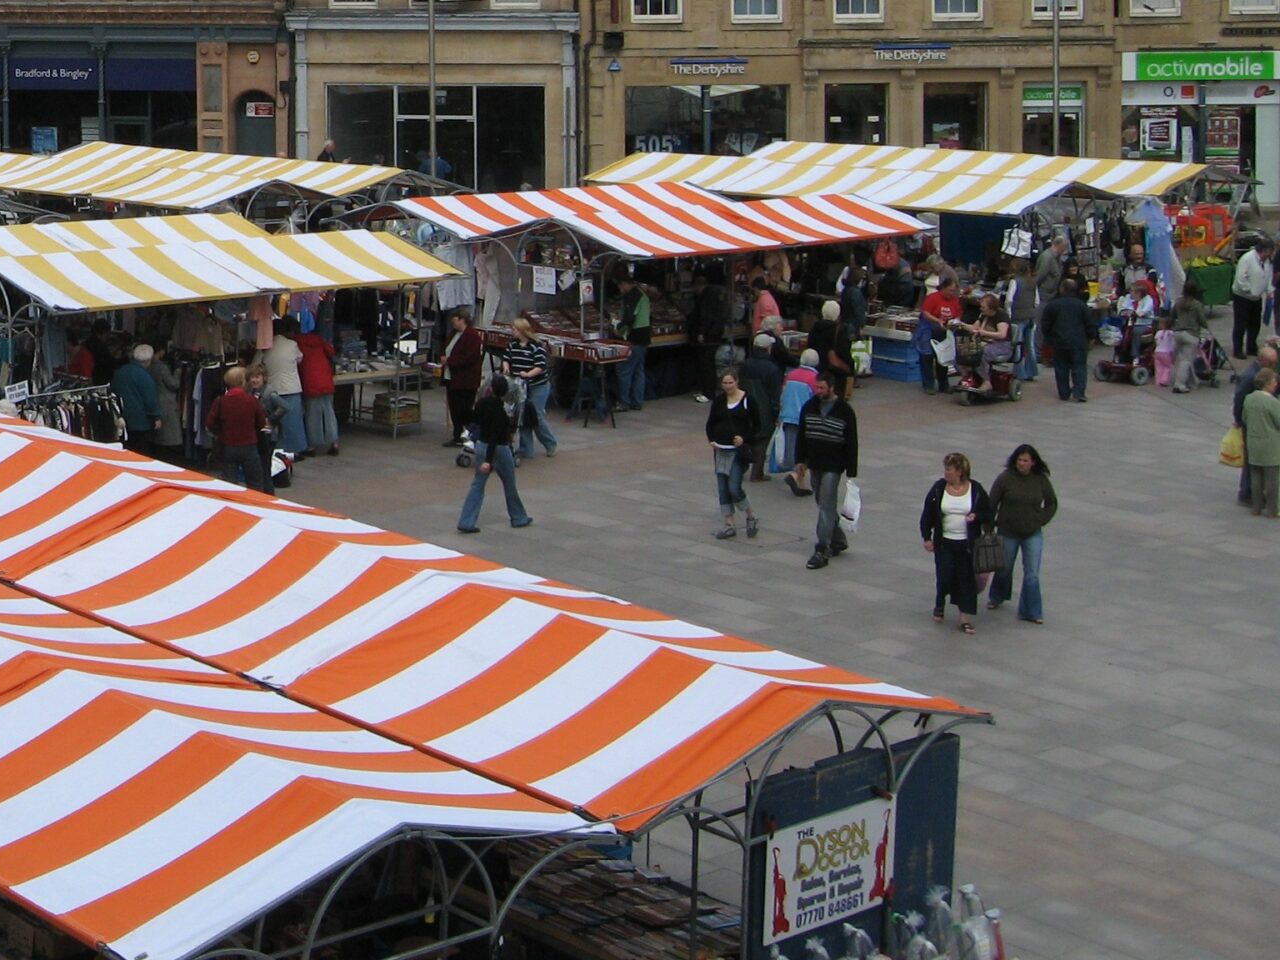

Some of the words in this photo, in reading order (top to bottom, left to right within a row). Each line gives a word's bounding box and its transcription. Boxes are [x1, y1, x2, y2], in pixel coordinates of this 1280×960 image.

[894, 49, 946, 64] Derbyshire
[692, 63, 745, 77] Derbyshire
[1147, 56, 1264, 77] activmobile
[15, 68, 51, 78] Bradford
[52, 69, 58, 78] &
[60, 68, 90, 80] Bingley
[797, 827, 815, 840] THE
[795, 907, 825, 928] 07770
[828, 892, 864, 917] 848661
